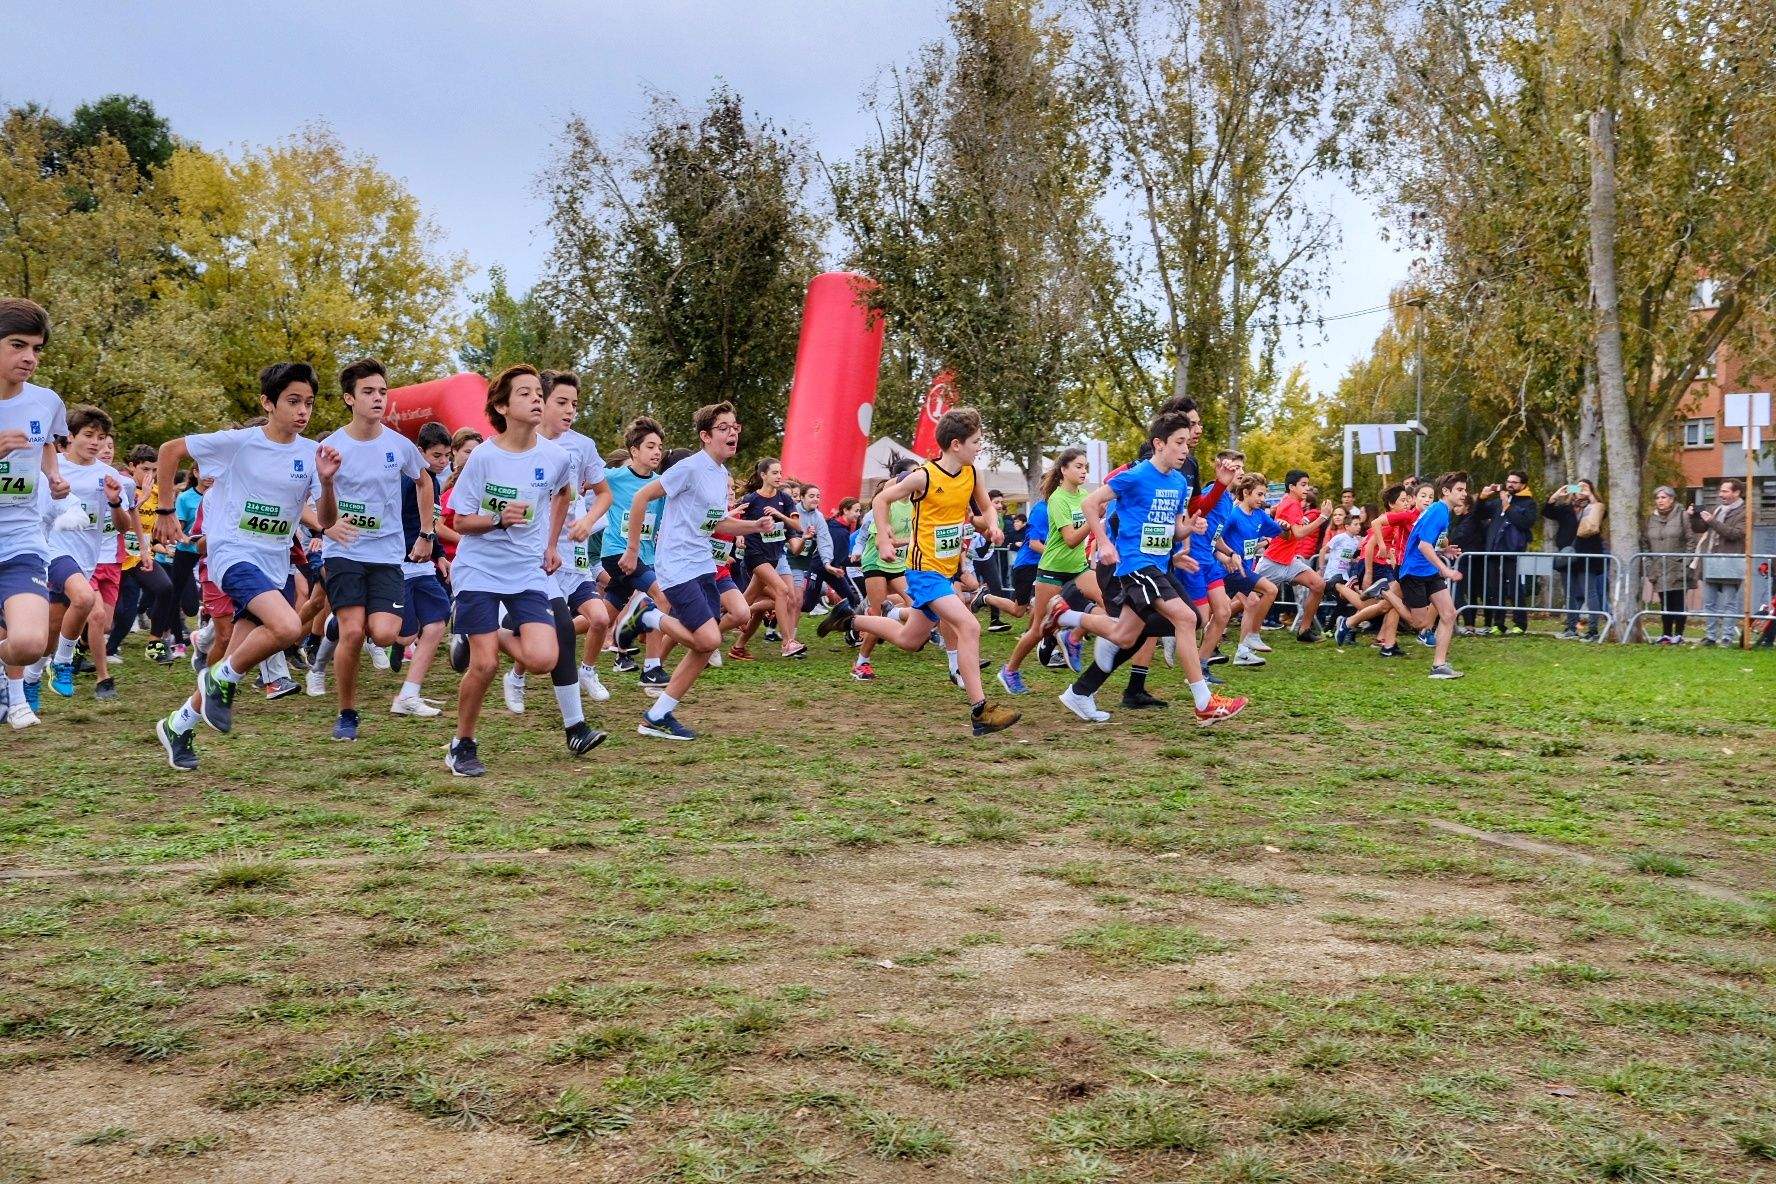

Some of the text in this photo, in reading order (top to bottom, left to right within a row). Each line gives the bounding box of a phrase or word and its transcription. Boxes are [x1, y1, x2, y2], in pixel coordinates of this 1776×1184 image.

[498, 486, 517, 496] CROS
[260, 505, 280, 513] CROS
[247, 515, 289, 534] 4670
